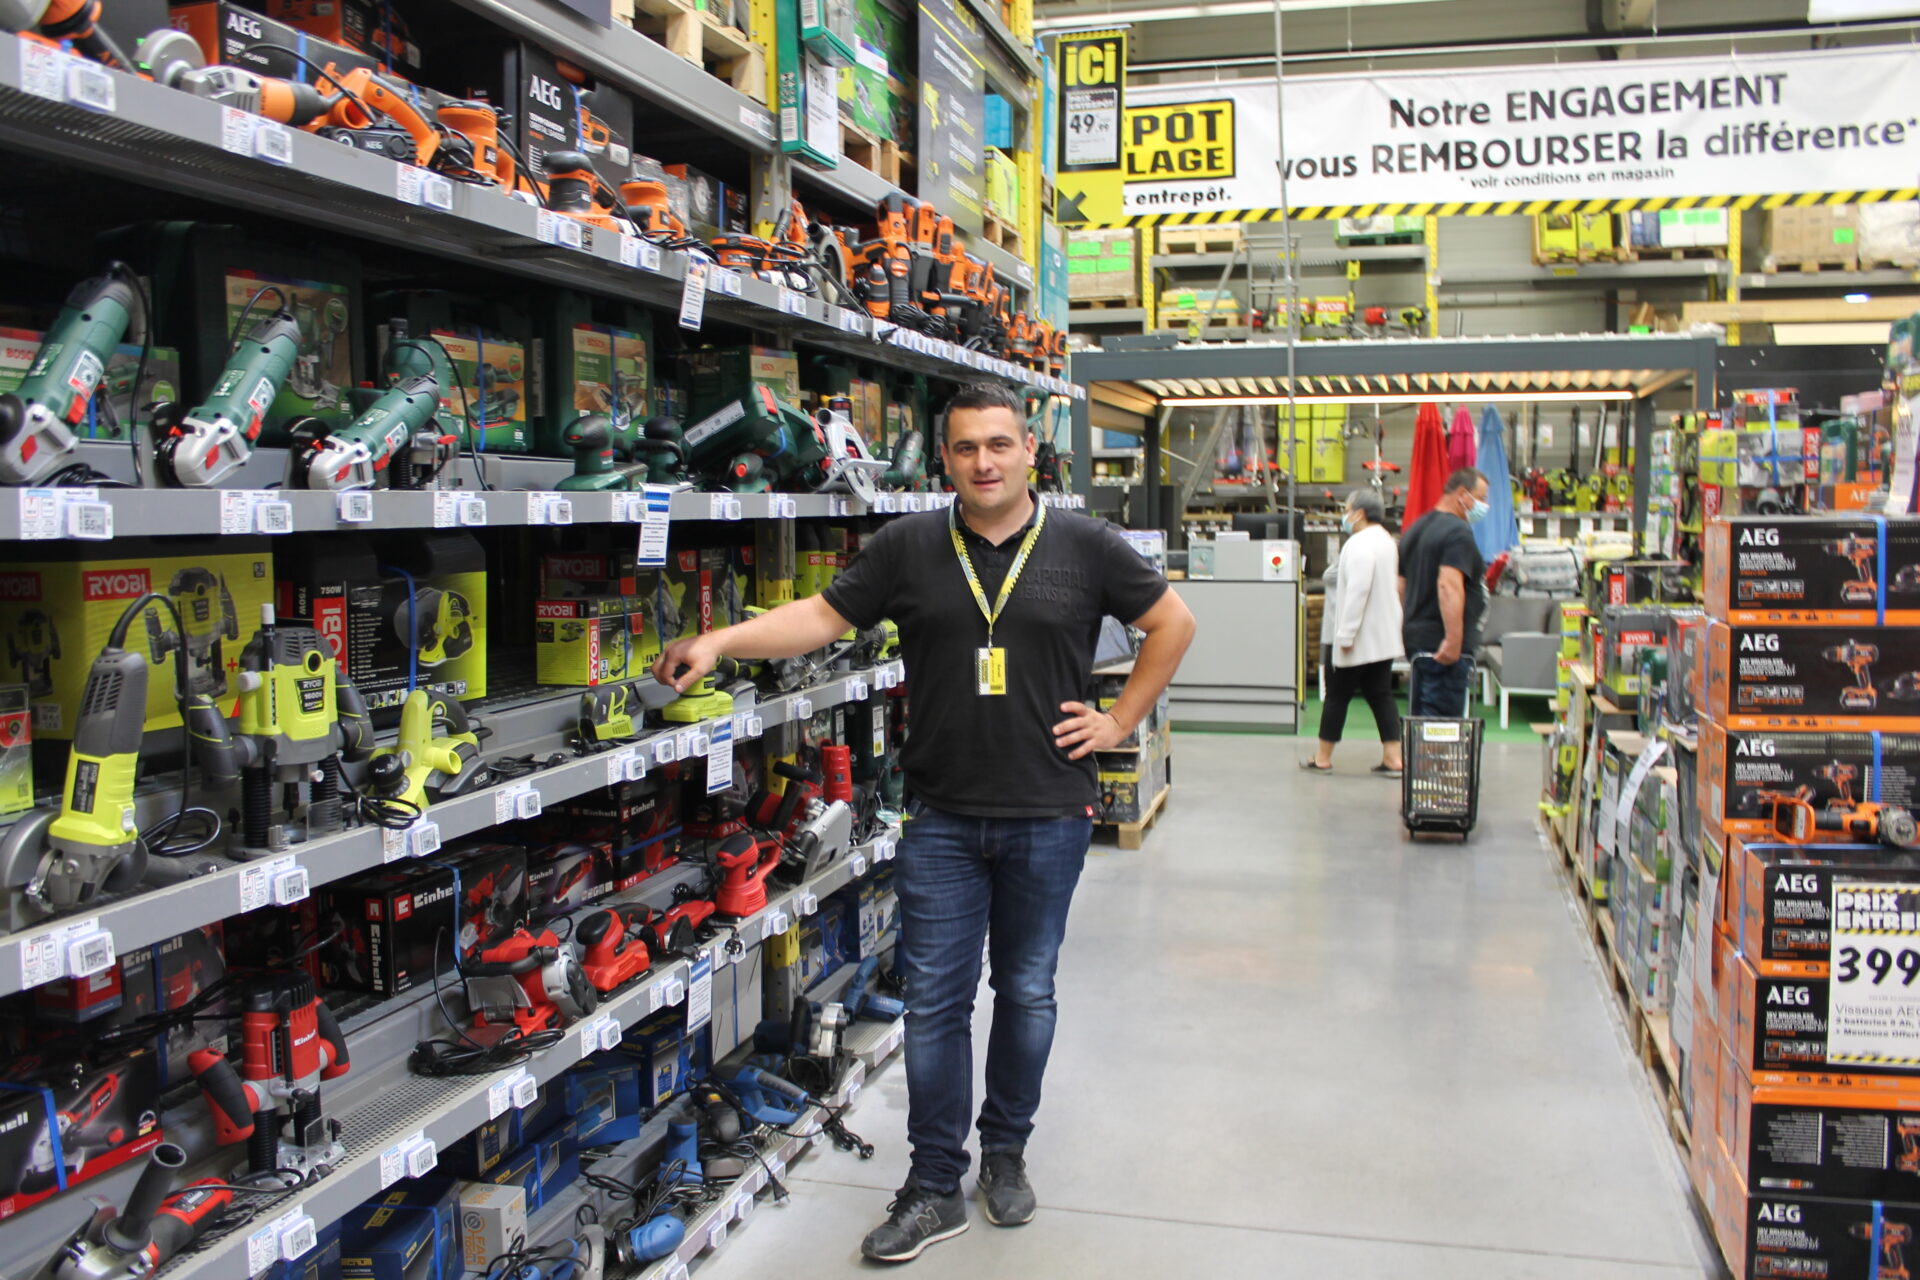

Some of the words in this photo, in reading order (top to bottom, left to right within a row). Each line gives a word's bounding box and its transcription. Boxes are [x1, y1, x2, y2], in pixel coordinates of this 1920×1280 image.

[226, 12, 262, 39] AEG
[528, 74, 562, 111] AEG
[1390, 98, 1490, 128] Notre
[1506, 73, 1788, 123] ENGAGEMENT
[1124, 105, 1223, 146] PÔT
[1276, 154, 1358, 180] vous
[1372, 131, 1643, 174] REMBOURSER
[1656, 128, 1689, 159] la
[1471, 173, 1498, 188] voir
[1504, 169, 1582, 187] conditions
[1587, 170, 1606, 182] en
[1611, 165, 1675, 183] magasin
[1135, 185, 1232, 210] entrepôt.
[1739, 527, 1780, 546] AEG
[88, 573, 147, 597] RYOBI
[320, 585, 342, 595] 750W
[537, 604, 573, 617] RYOBI
[590, 625, 599, 682] RYOBI
[1739, 633, 1780, 652] AEG
[1735, 738, 1777, 757] AEG
[630, 799, 656, 816] Einhell
[413, 879, 462, 910] Einhel
[1774, 873, 1818, 894] AEG
[1837, 892, 1899, 911] PRIX
[370, 923, 384, 992] Einhell
[1838, 947, 1920, 986] 399
[1767, 985, 1810, 1005] AEG
[1835, 1003, 1893, 1015] Visseuse
[1844, 1016, 1888, 1025] batteries
[1844, 1027, 1890, 1037] Meuleuse
[1757, 1202, 1801, 1224] AEG
